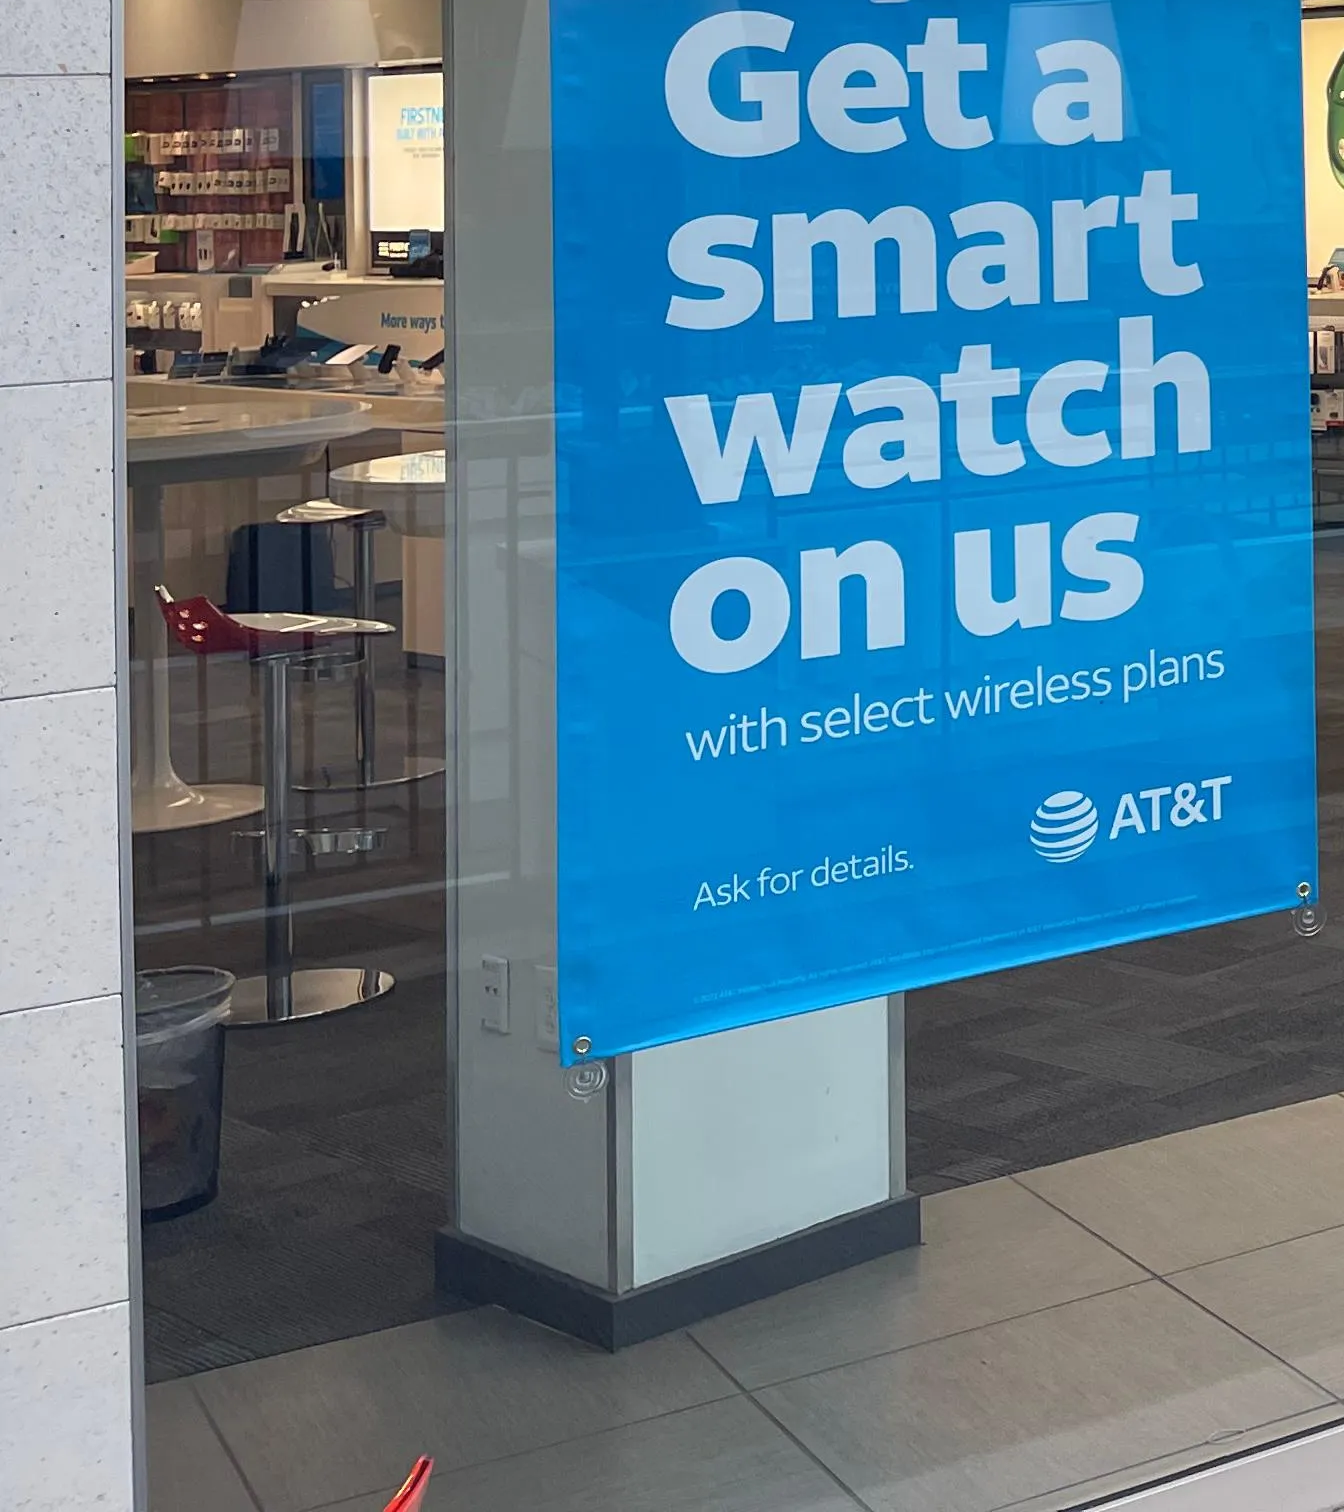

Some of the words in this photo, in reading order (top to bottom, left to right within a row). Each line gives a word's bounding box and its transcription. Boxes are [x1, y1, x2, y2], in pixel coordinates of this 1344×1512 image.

[400, 106, 444, 126] FIRSTN
[664, 9, 994, 158] Get
[1031, 37, 1125, 146] a
[664, 169, 1205, 332] smart
[380, 312, 407, 329] More
[410, 316, 437, 334] ways
[663, 314, 1213, 506] watch
[669, 538, 906, 675] on
[953, 510, 1145, 638] us
[685, 705, 788, 762] with
[799, 689, 936, 746] select
[944, 666, 1113, 720] wireless
[1122, 647, 1226, 705] plans
[1108, 775, 1233, 841] AT&T
[692, 873, 752, 911] Ask
[757, 865, 804, 898] for
[810, 844, 916, 889] details.
